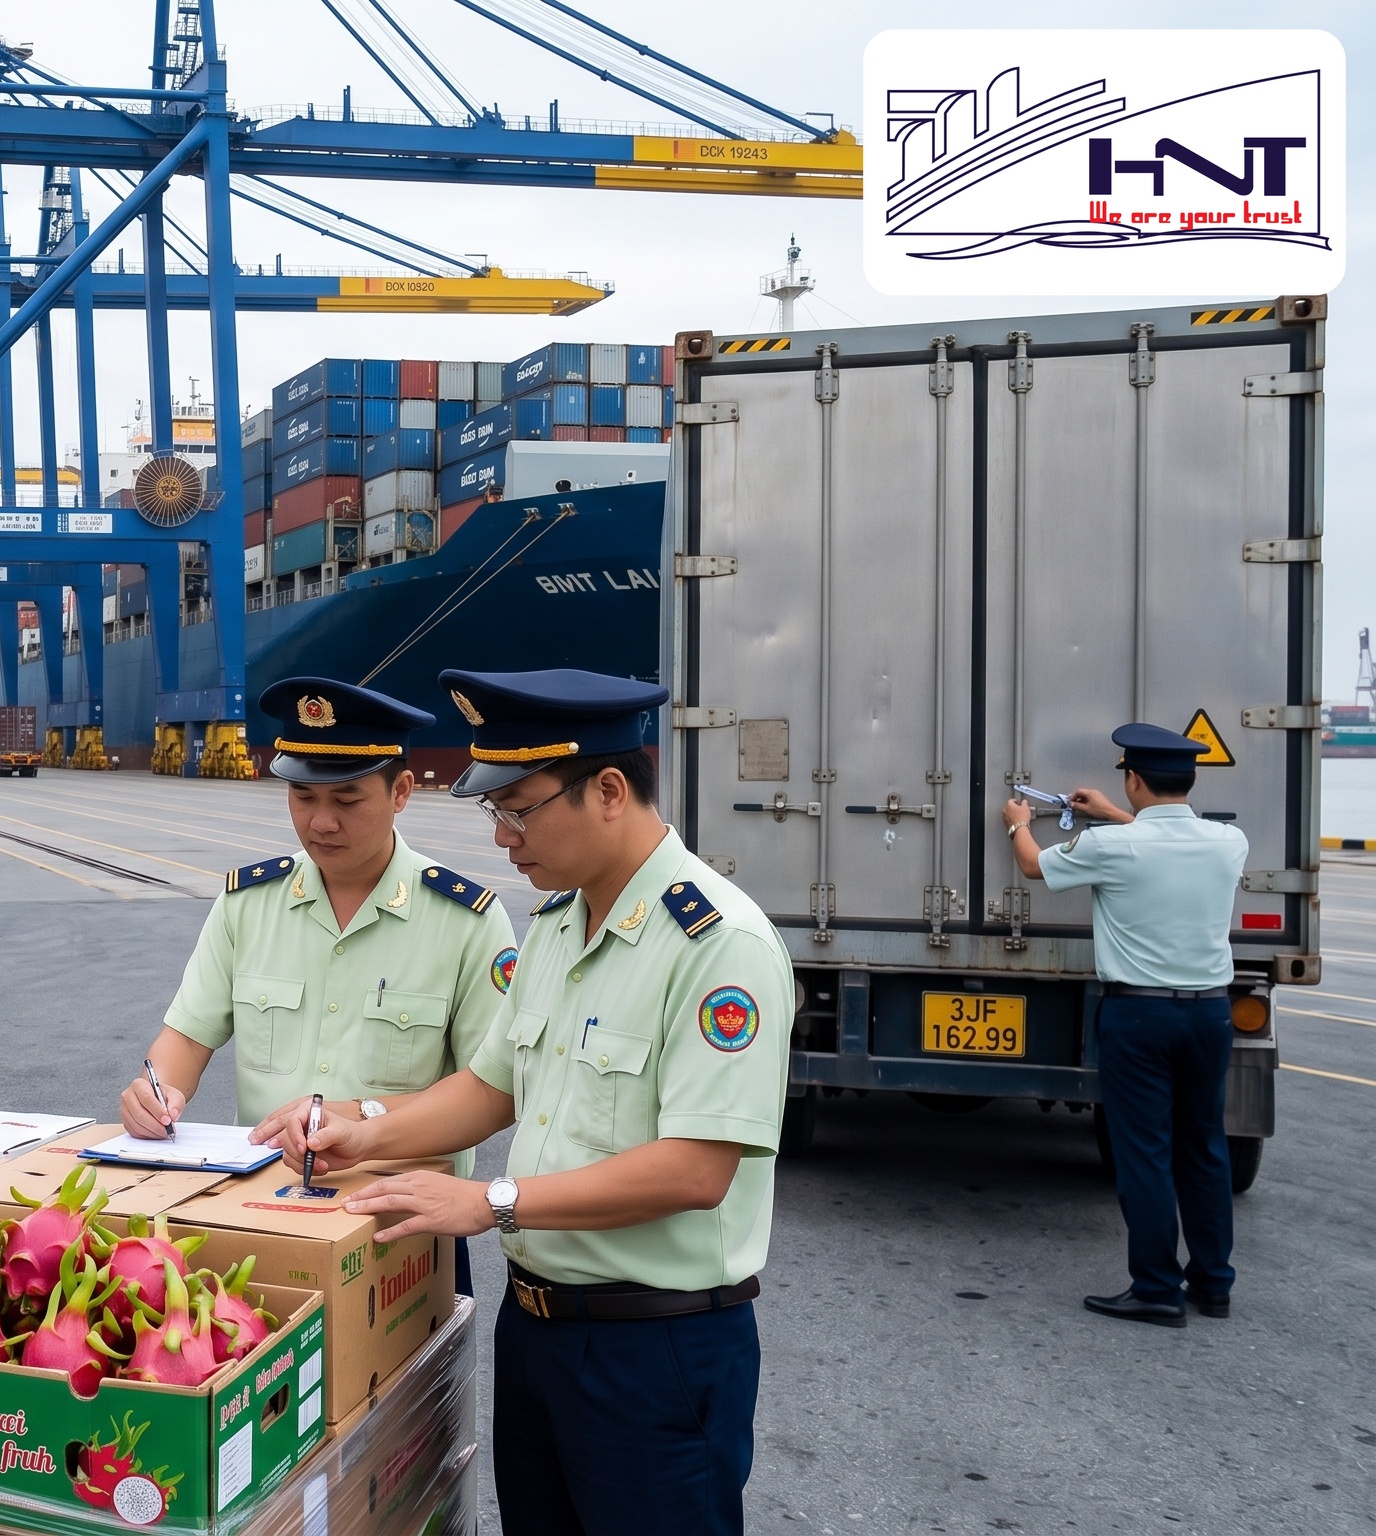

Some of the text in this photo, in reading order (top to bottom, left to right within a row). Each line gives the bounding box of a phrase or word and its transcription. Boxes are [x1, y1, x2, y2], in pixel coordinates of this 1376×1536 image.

[730, 147, 768, 160] 19243
[950, 997, 997, 1023] 3JF
[932, 1024, 1017, 1052] 162.99
